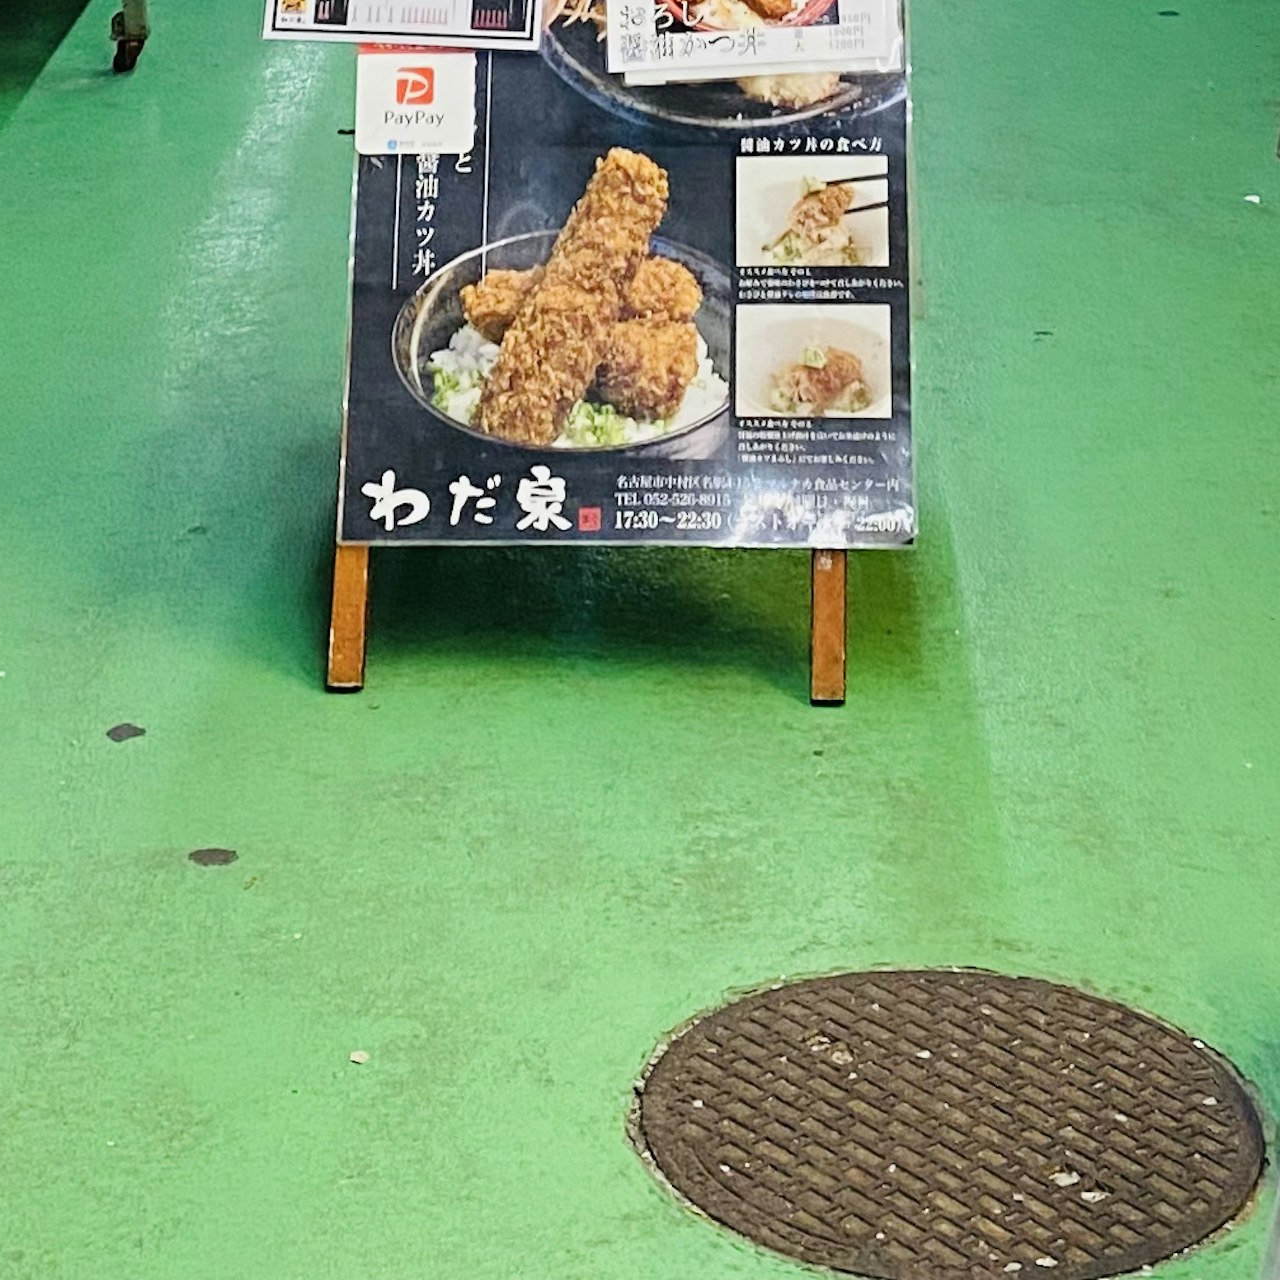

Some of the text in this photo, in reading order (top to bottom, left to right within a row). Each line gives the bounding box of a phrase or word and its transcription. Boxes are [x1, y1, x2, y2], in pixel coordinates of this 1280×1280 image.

[619, 1, 705, 31] おろし
[620, 26, 768, 63] 醤油かつ丼
[384, 110, 445, 128] PayPay
[739, 136, 883, 153] 醤油カツ丼の食べ方
[360, 465, 573, 533] わだ泉
[614, 493, 642, 507] TEL
